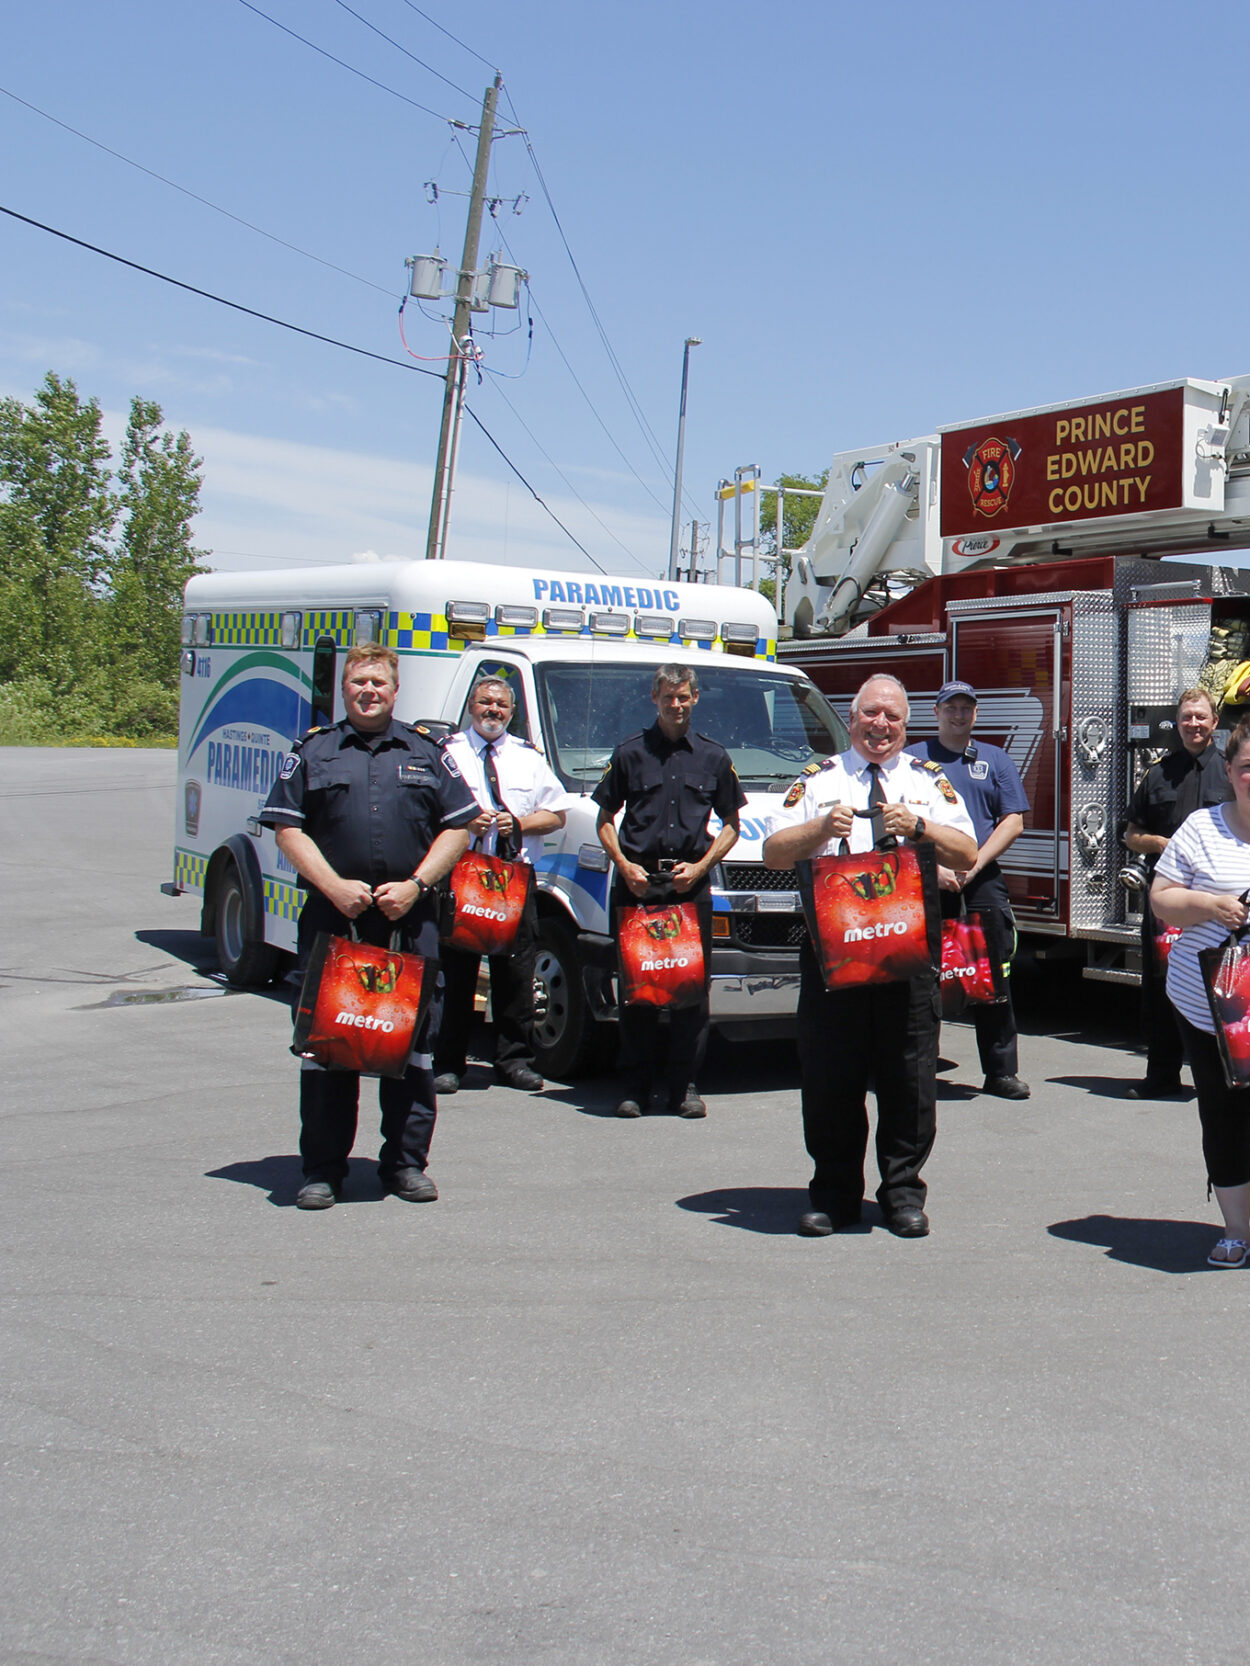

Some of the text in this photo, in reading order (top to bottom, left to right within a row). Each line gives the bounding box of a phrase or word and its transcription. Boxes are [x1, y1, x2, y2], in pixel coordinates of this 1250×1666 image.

[1056, 405, 1146, 446] PRINCE
[982, 447, 1001, 461] FIRE
[1046, 440, 1155, 481] EDWARD
[980, 496, 1003, 507] RESCUE
[1048, 475, 1152, 514] COUNTY
[532, 578, 680, 611] PARAMEDIC
[461, 903, 507, 922] metro
[843, 921, 908, 943] metro
[641, 957, 689, 972] metro
[335, 1011, 395, 1034] metro
